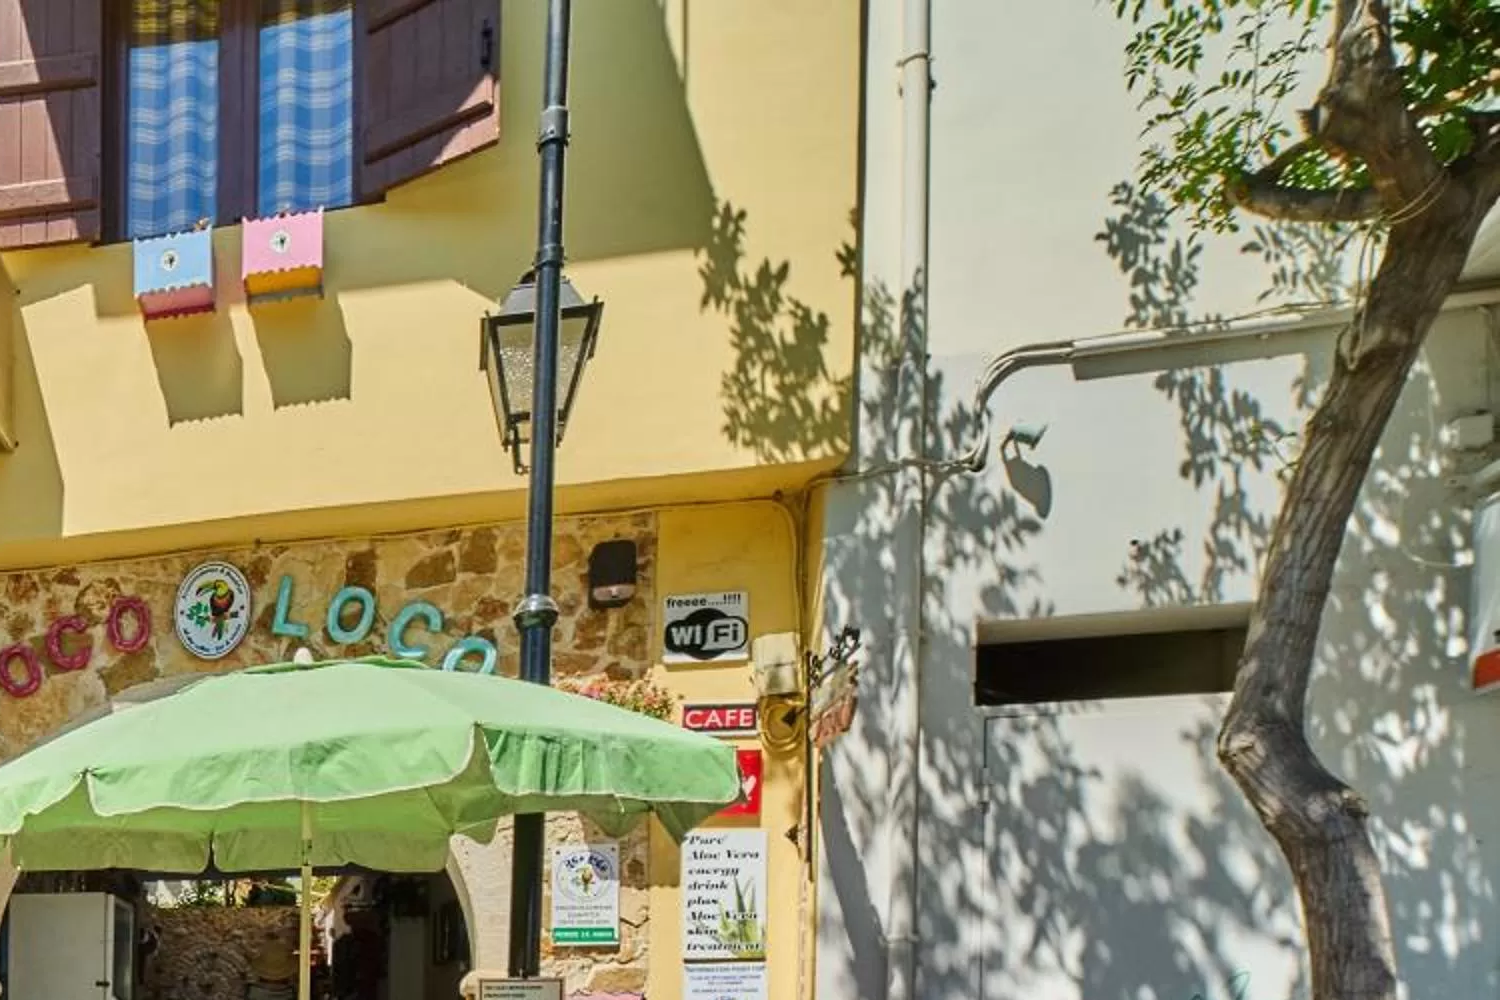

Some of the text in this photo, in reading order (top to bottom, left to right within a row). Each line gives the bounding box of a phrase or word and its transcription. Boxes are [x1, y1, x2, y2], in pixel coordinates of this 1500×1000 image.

[271, 575, 498, 674] LOCO
[685, 708, 754, 729] CAFE
[689, 836, 722, 845] Pure
[688, 849, 760, 860] Aloe Vera
[688, 867, 740, 877] energy
[687, 881, 728, 890] drink
[687, 896, 718, 907] plus
[687, 911, 758, 920] Aloe Vera
[686, 926, 718, 936] skin
[686, 943, 760, 952] treatment
